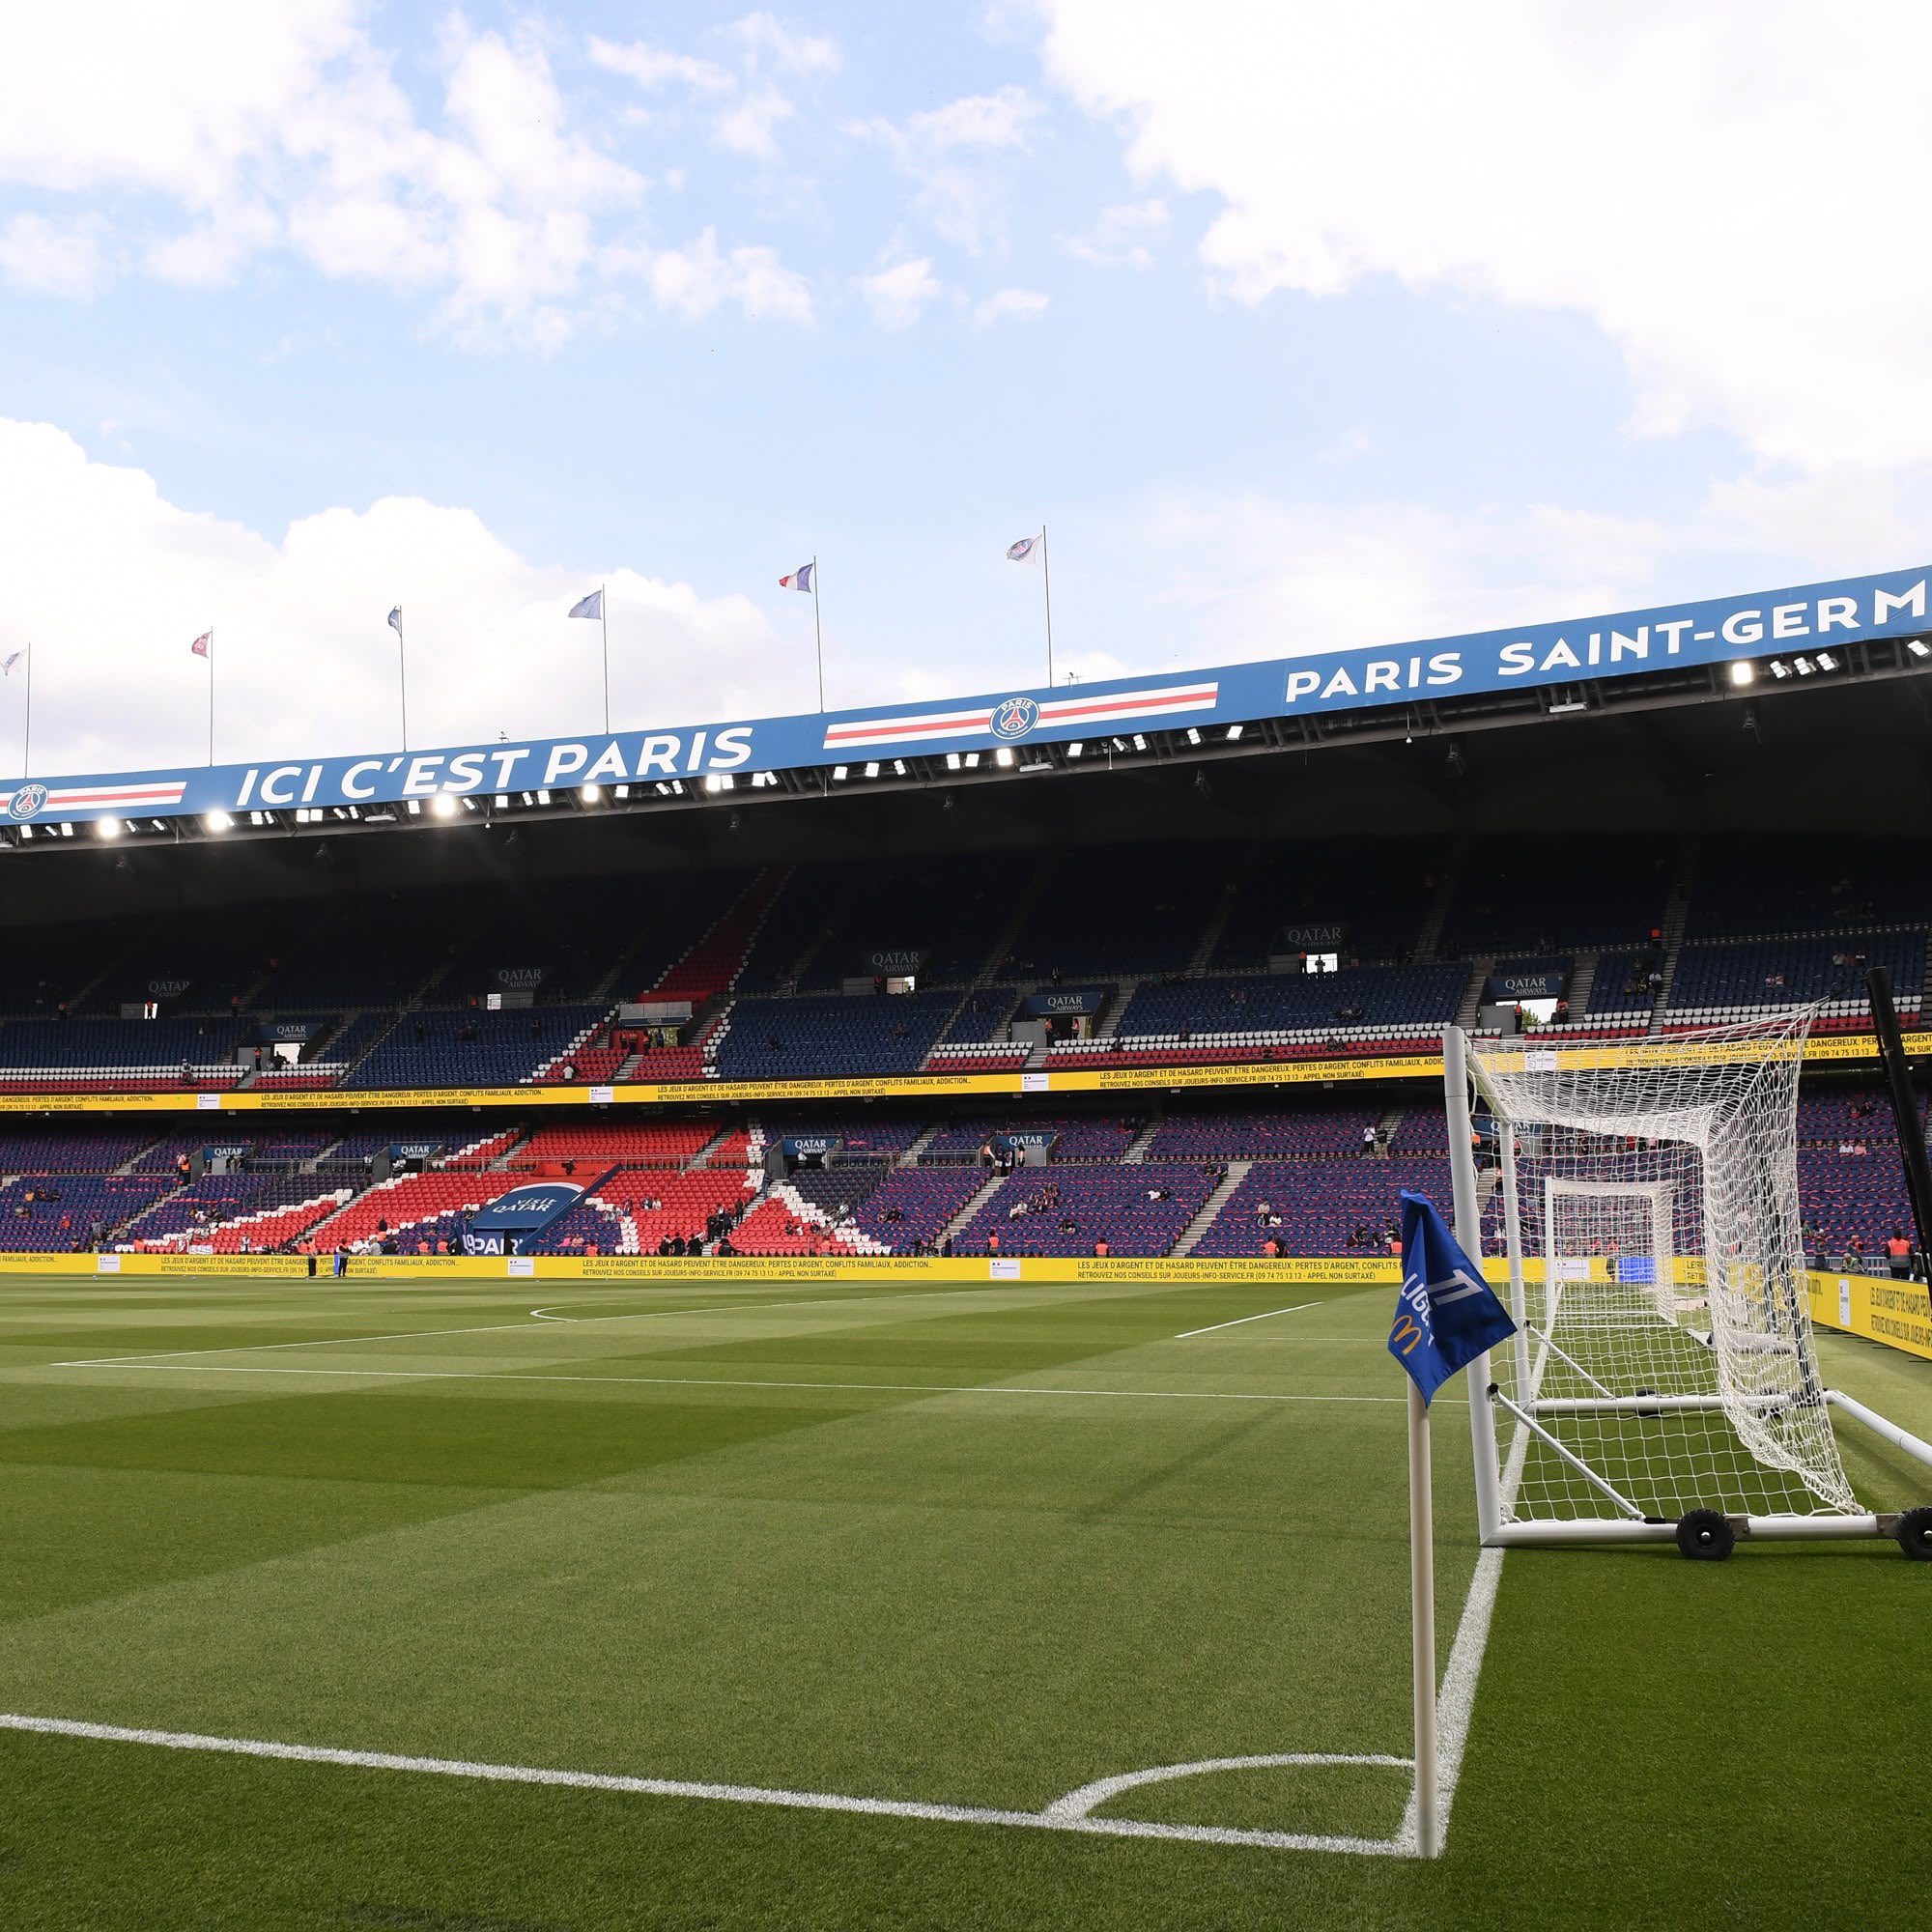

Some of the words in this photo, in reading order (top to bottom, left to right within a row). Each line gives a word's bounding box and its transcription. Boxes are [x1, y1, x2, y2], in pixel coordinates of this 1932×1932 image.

[1286, 653, 1463, 703] PARIS
[1001, 699, 1033, 711] PARIS
[236, 766, 325, 806] ICI
[341, 748, 530, 799] C'EST
[543, 726, 754, 784] PARIS
[1288, 926, 1342, 944] QATAR
[872, 952, 920, 966] QATAR
[882, 964, 920, 974] AIRWAYS
[498, 968, 542, 982] QATAR
[1505, 977, 1547, 990] QATAR
[1047, 995, 1083, 1008] QATAR
[276, 1025, 306, 1035] QATAR
[1204, 1066, 1233, 1075] PEUVENT
[1251, 1065, 1291, 1073] DANGEREUX:
[1318, 1062, 1350, 1071] D'ARGENT,
[1385, 1059, 1421, 1068] FAMILIAUX,
[794, 1139, 826, 1150] QATAR
[1009, 1135, 1043, 1146] QATAR
[214, 1148, 242, 1156] QATAR
[401, 1146, 430, 1155] QATAR
[493, 1204, 551, 1213] QATAR
[712, 1259, 726, 1267] ÊTRE
[792, 1260, 824, 1268] D'ARGENT,
[1230, 1260, 1246, 1269] ÊTRE
[1323, 1262, 1360, 1270] D'ARGENT,
